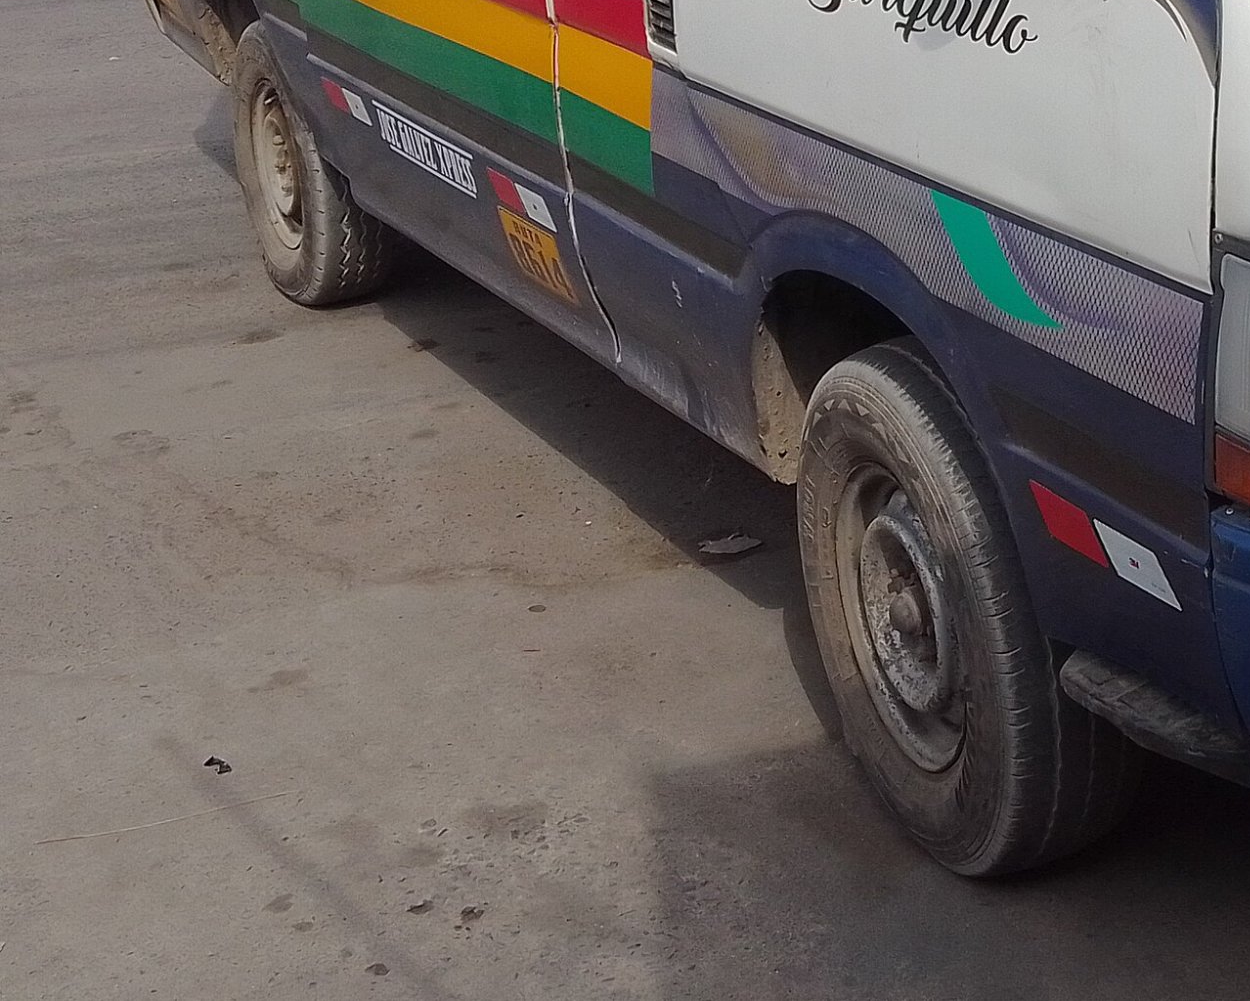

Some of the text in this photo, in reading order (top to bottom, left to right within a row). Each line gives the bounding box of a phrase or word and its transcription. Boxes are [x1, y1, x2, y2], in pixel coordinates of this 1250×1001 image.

[376, 108, 478, 194] JOSE GALVEZ XPRESS
[512, 220, 543, 248] RUTA
